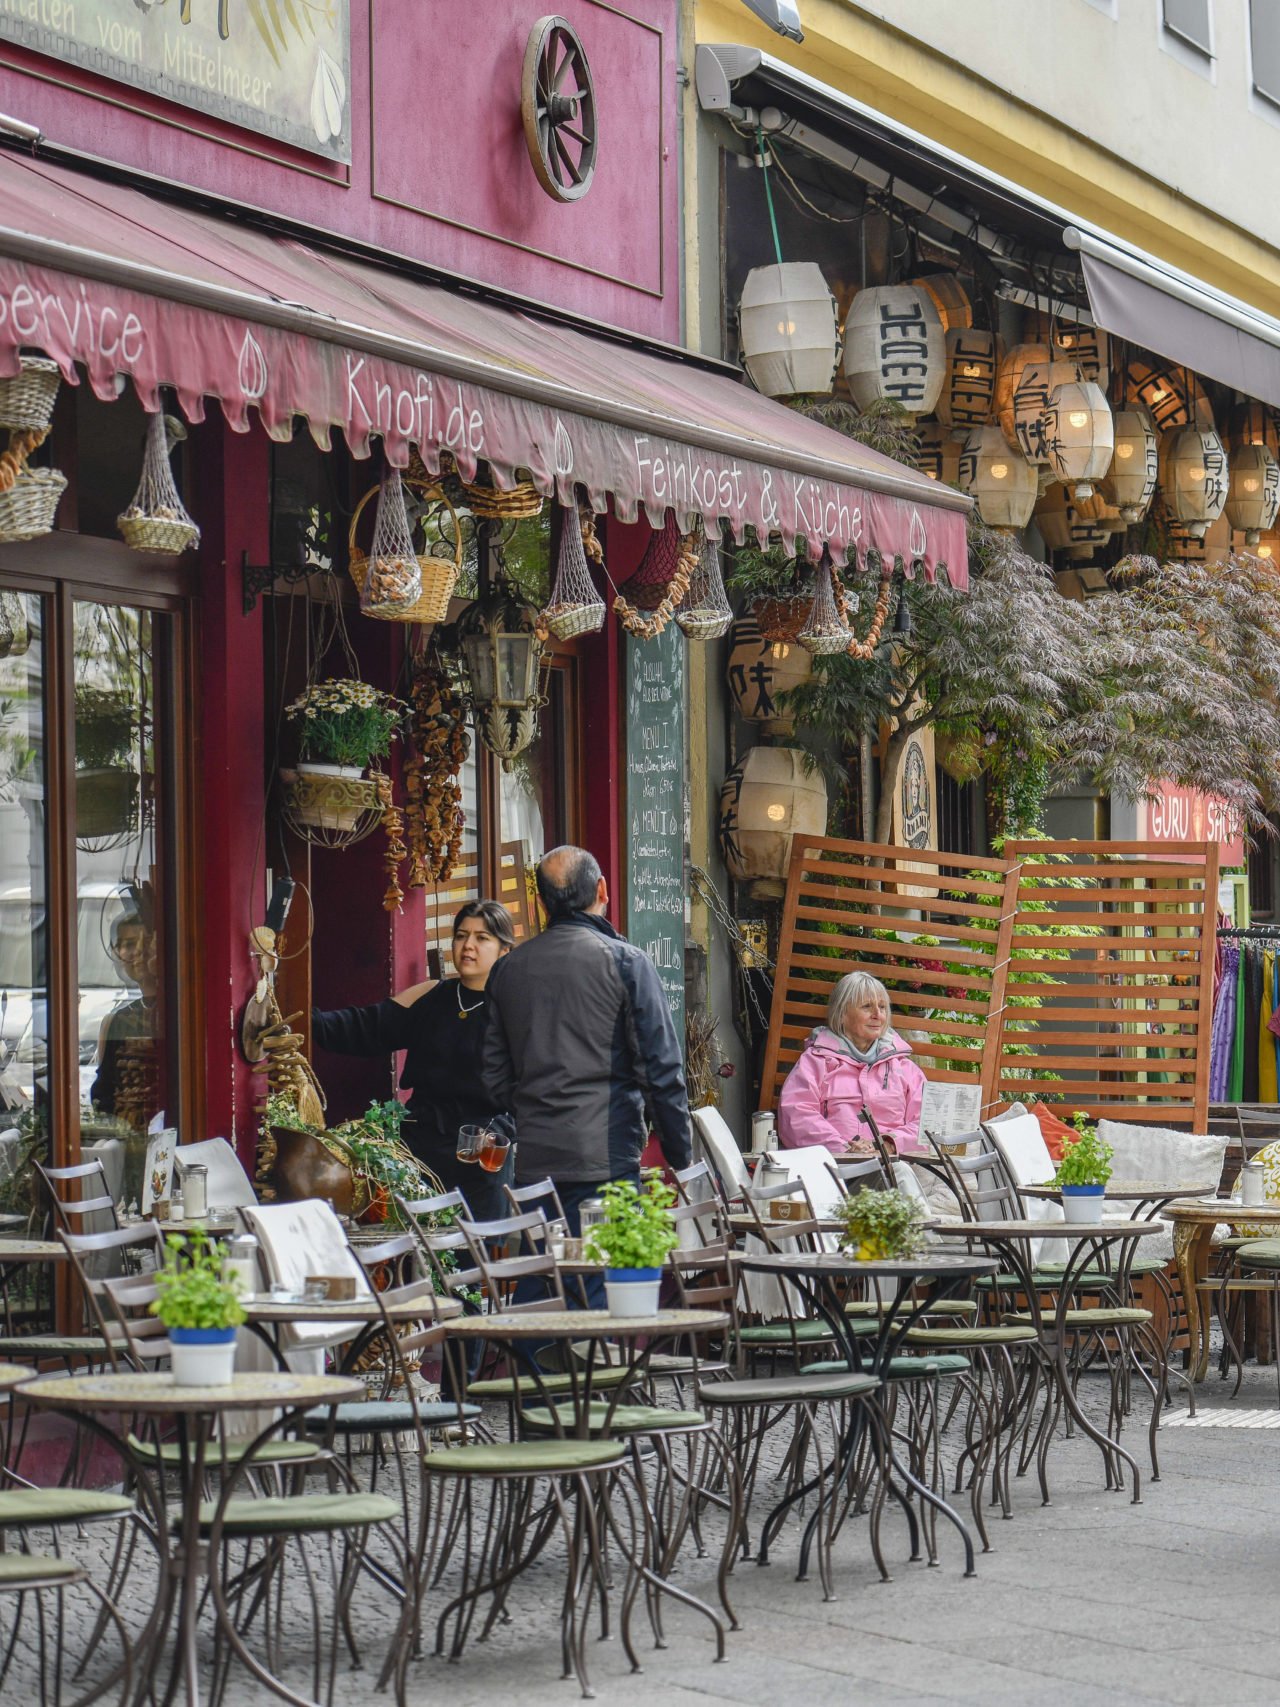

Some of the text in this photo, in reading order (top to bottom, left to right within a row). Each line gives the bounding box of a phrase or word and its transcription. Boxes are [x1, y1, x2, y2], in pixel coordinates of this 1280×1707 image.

[97, 16, 143, 61] vom
[163, 32, 272, 108] Mittelmeer
[345, 353, 484, 453] Knofi.de
[633, 436, 747, 509] Feinkost
[760, 468, 780, 526] &
[793, 476, 863, 541] Küche
[1152, 793, 1239, 845] GURU SHOP
